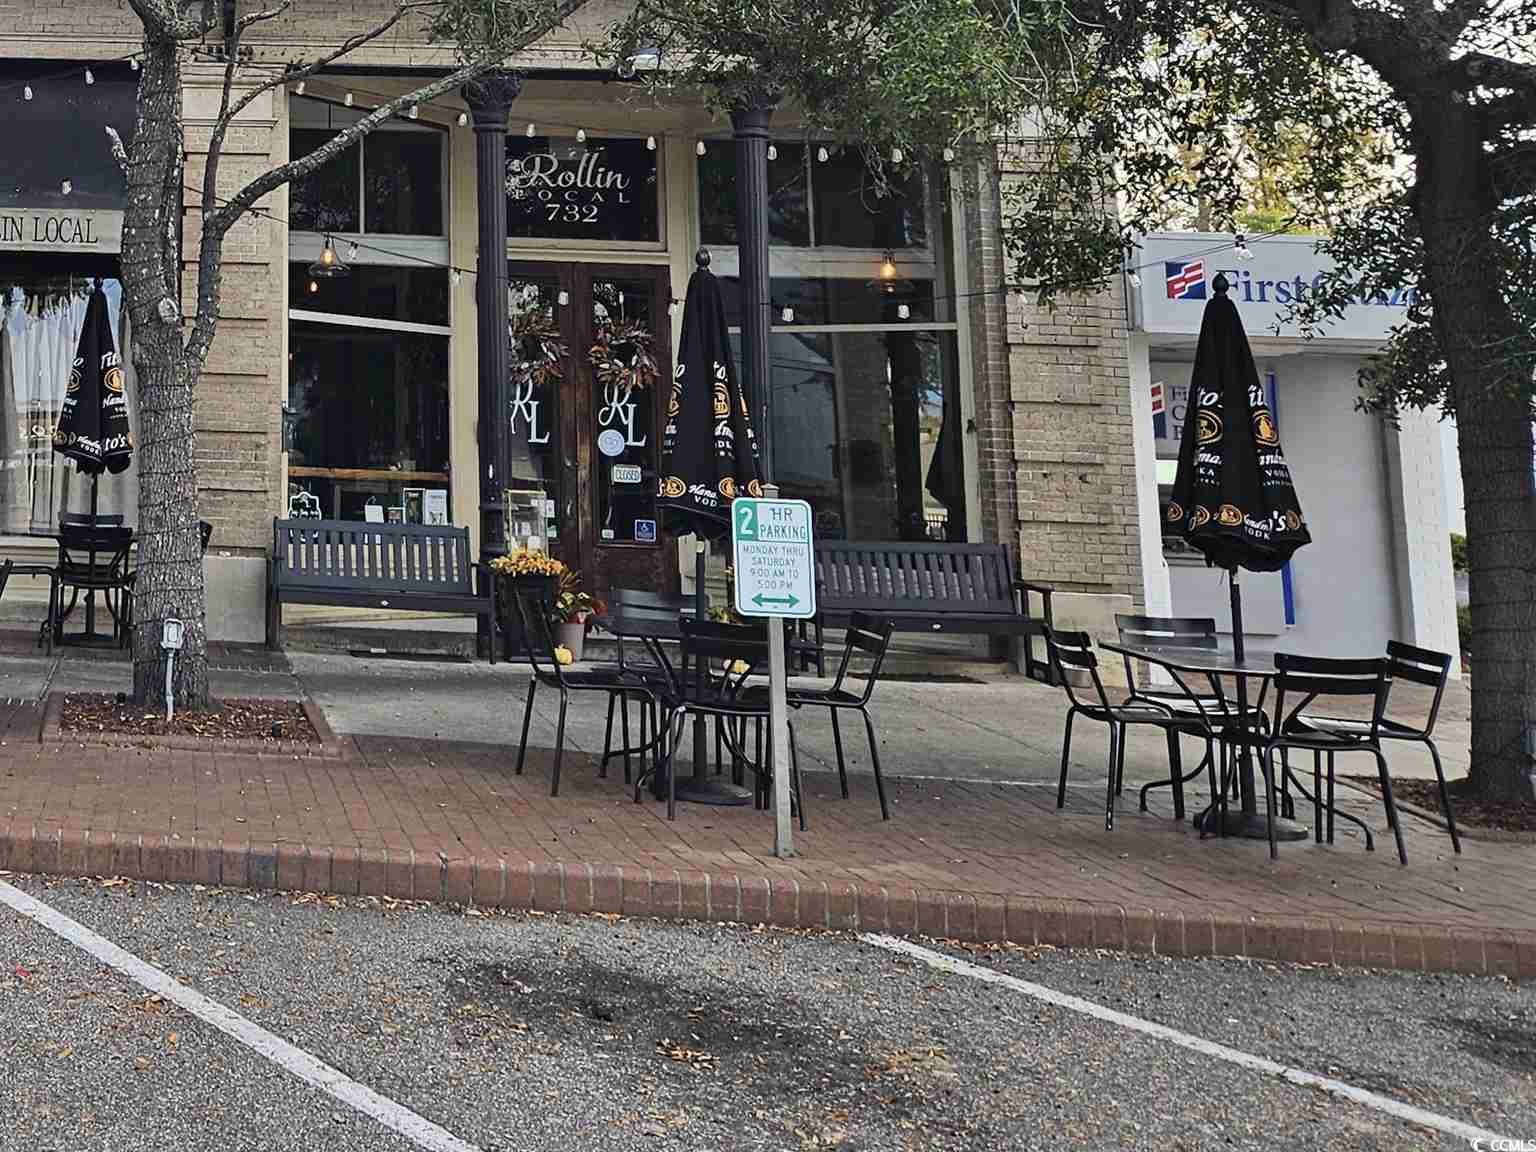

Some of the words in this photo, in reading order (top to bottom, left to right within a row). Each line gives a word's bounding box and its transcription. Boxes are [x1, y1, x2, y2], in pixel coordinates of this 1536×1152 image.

[517, 152, 631, 189] Rollin
[545, 203, 599, 223] 732
[32, 216, 98, 244] LOCAL
[615, 469, 641, 481] CLOSED
[739, 507, 754, 535] 2
[769, 507, 793, 521] HR
[759, 524, 807, 539] PARKING
[743, 544, 778, 556] MONDAY
[751, 557, 795, 567] SATURDAY
[772, 568, 785, 578] AM
